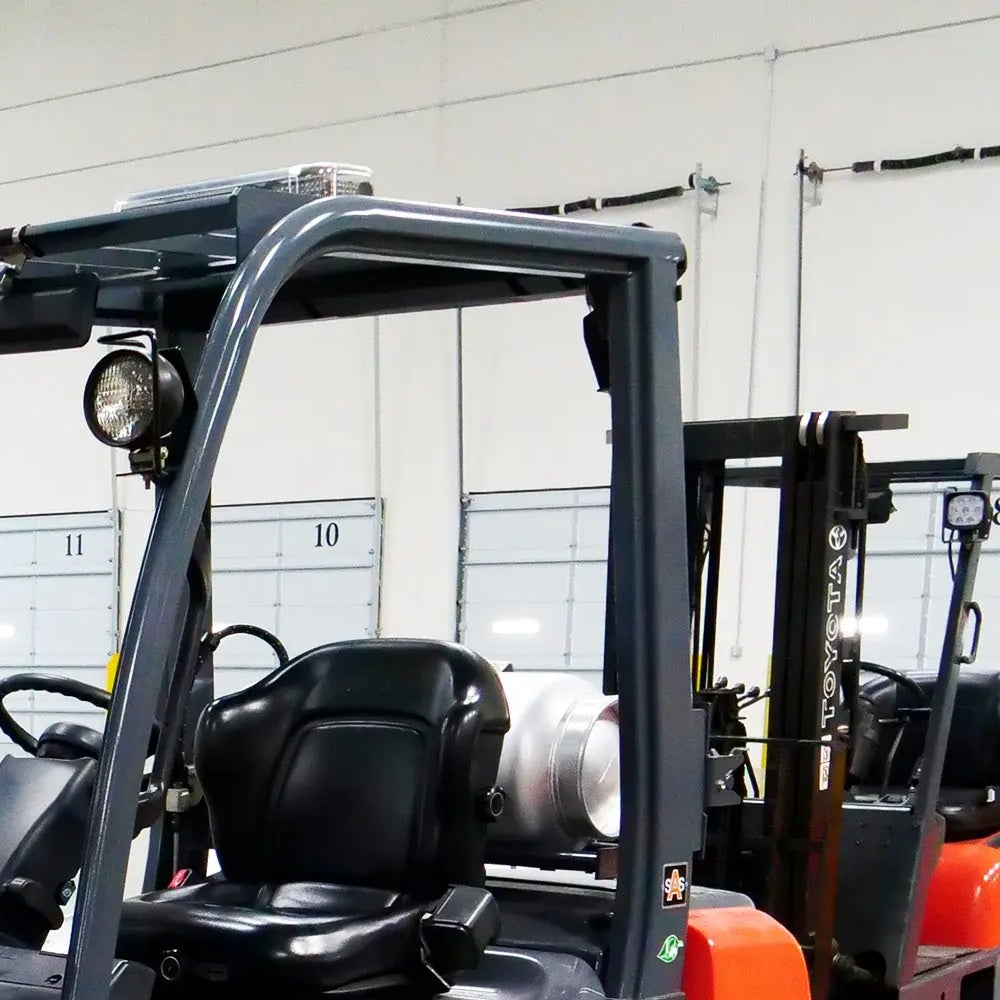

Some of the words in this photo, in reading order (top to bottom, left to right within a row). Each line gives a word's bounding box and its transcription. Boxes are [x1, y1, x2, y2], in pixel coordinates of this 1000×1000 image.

[65, 534, 83, 556] 11
[315, 522, 339, 547] 10
[822, 555, 843, 728] TOYOTA
